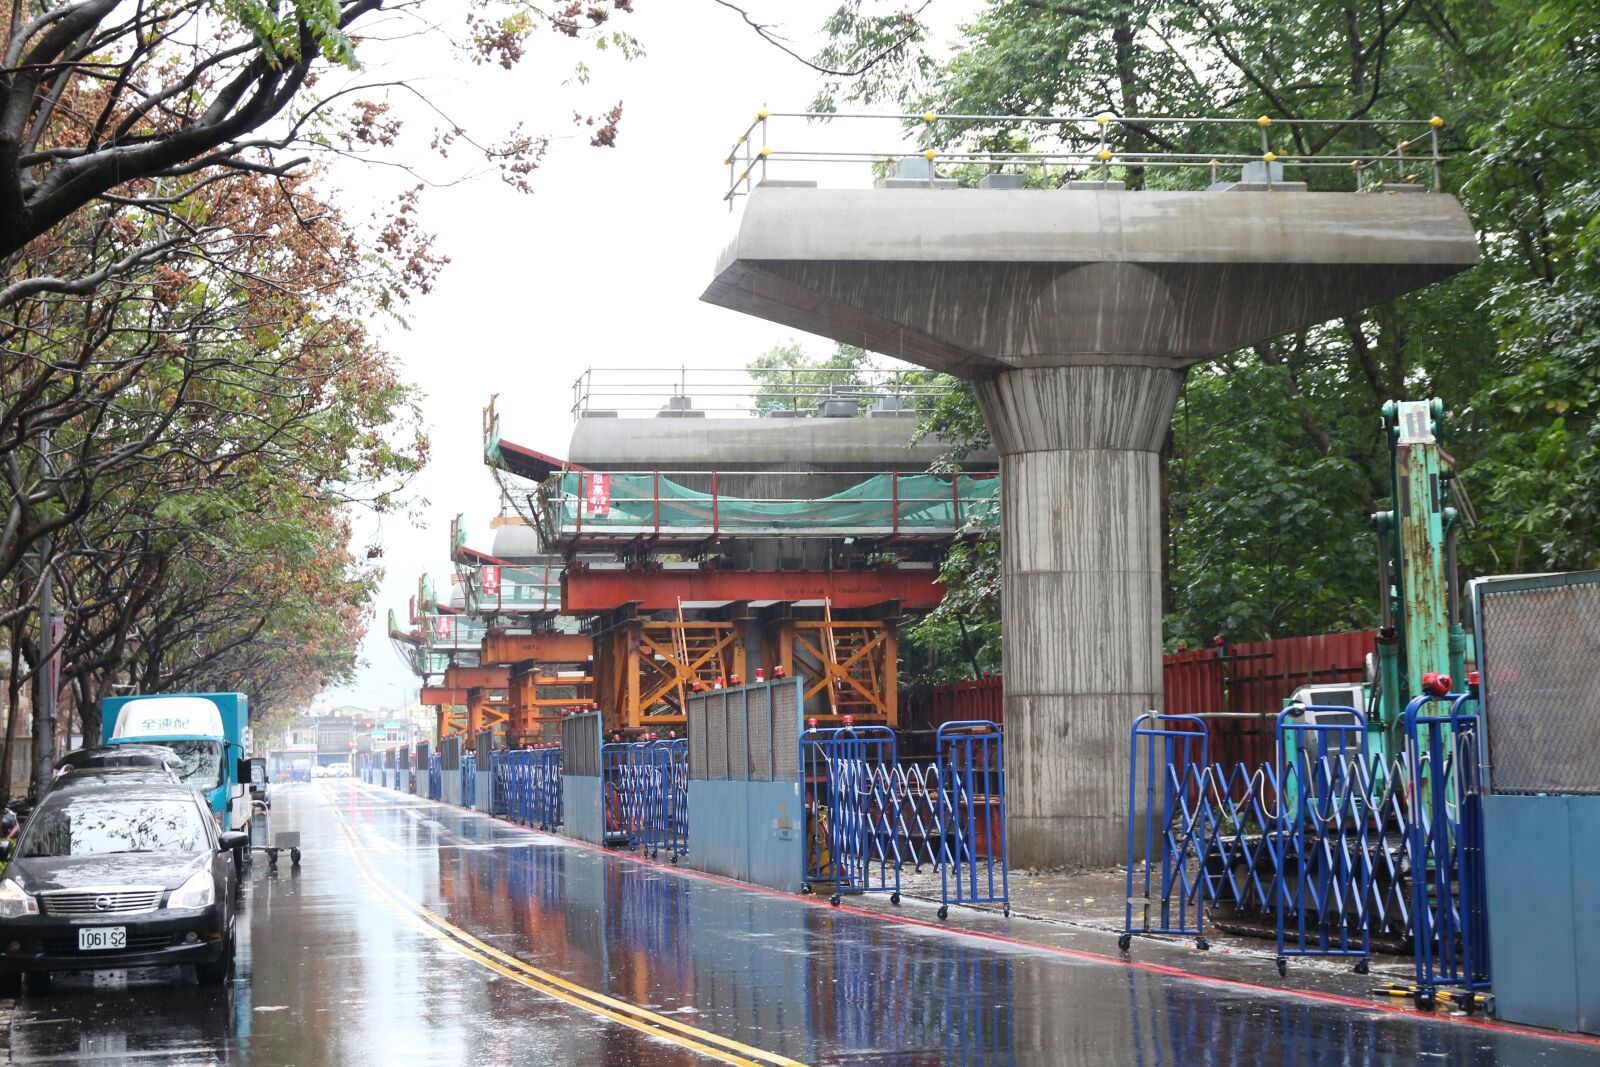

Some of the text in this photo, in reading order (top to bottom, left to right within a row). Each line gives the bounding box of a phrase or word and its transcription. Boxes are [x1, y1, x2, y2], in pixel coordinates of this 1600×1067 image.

[590, 496, 606, 505] 4.2
[594, 505, 602, 514] M
[141, 718, 190, 731] 全速配
